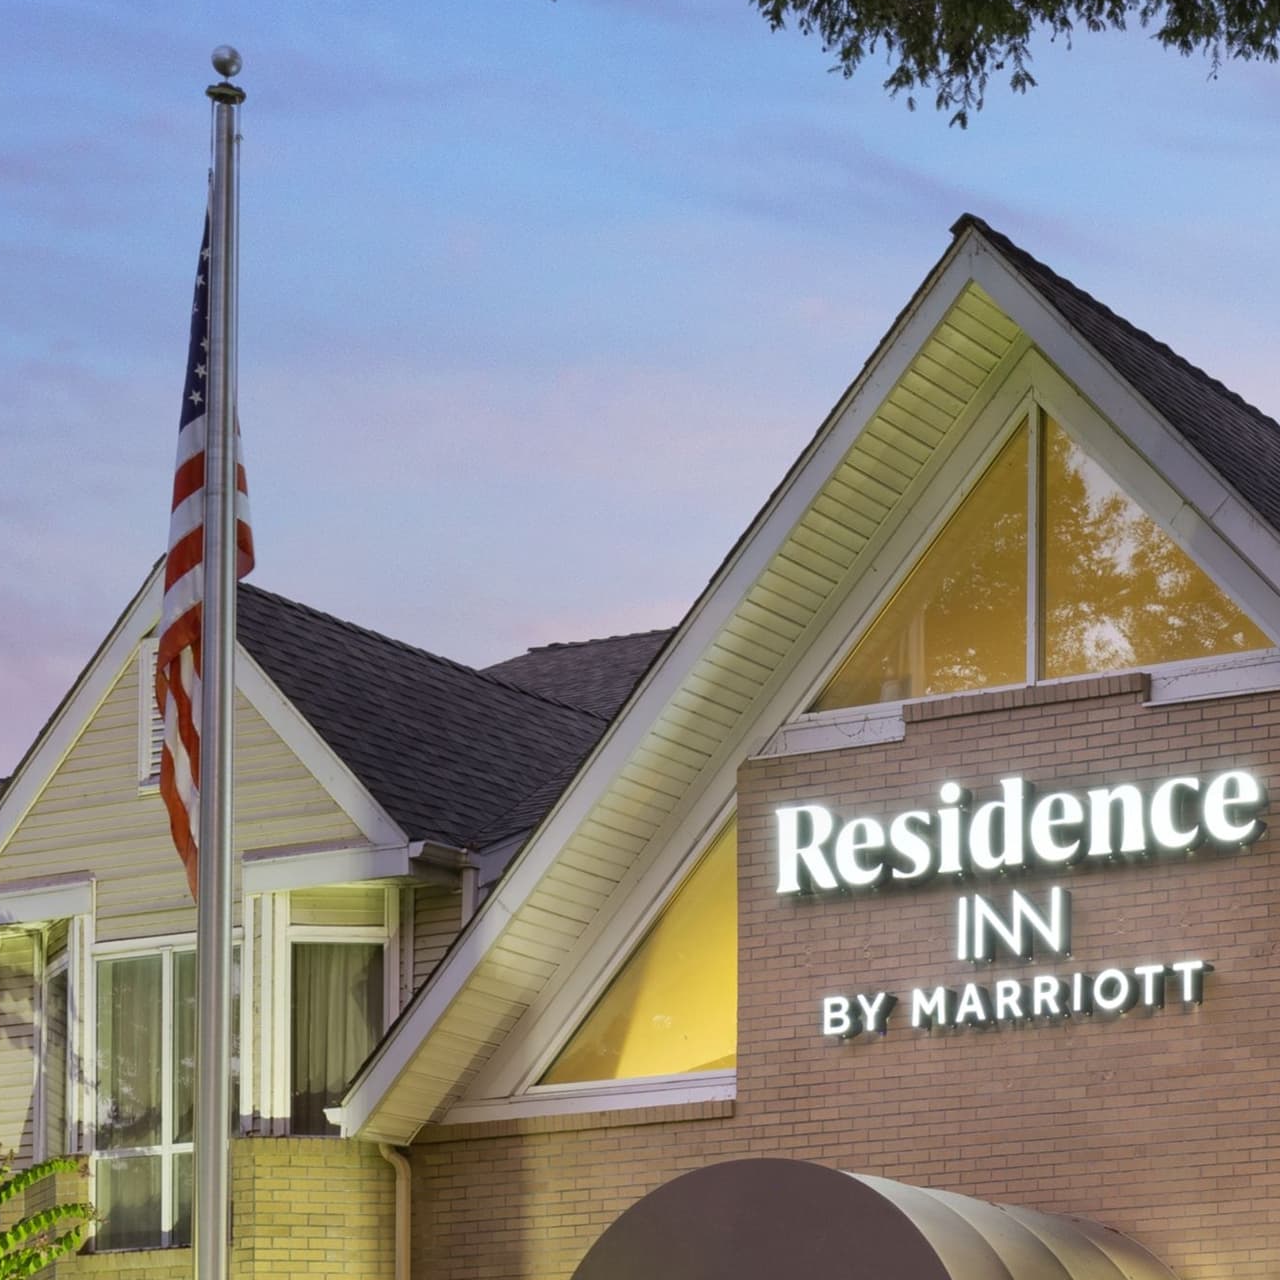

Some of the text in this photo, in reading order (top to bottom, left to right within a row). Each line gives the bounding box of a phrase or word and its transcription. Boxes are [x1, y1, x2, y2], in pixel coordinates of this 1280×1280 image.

[775, 769, 1261, 894] Residence
[957, 886, 1062, 960] INN
[823, 960, 1205, 1035] BY MARRIOTT
